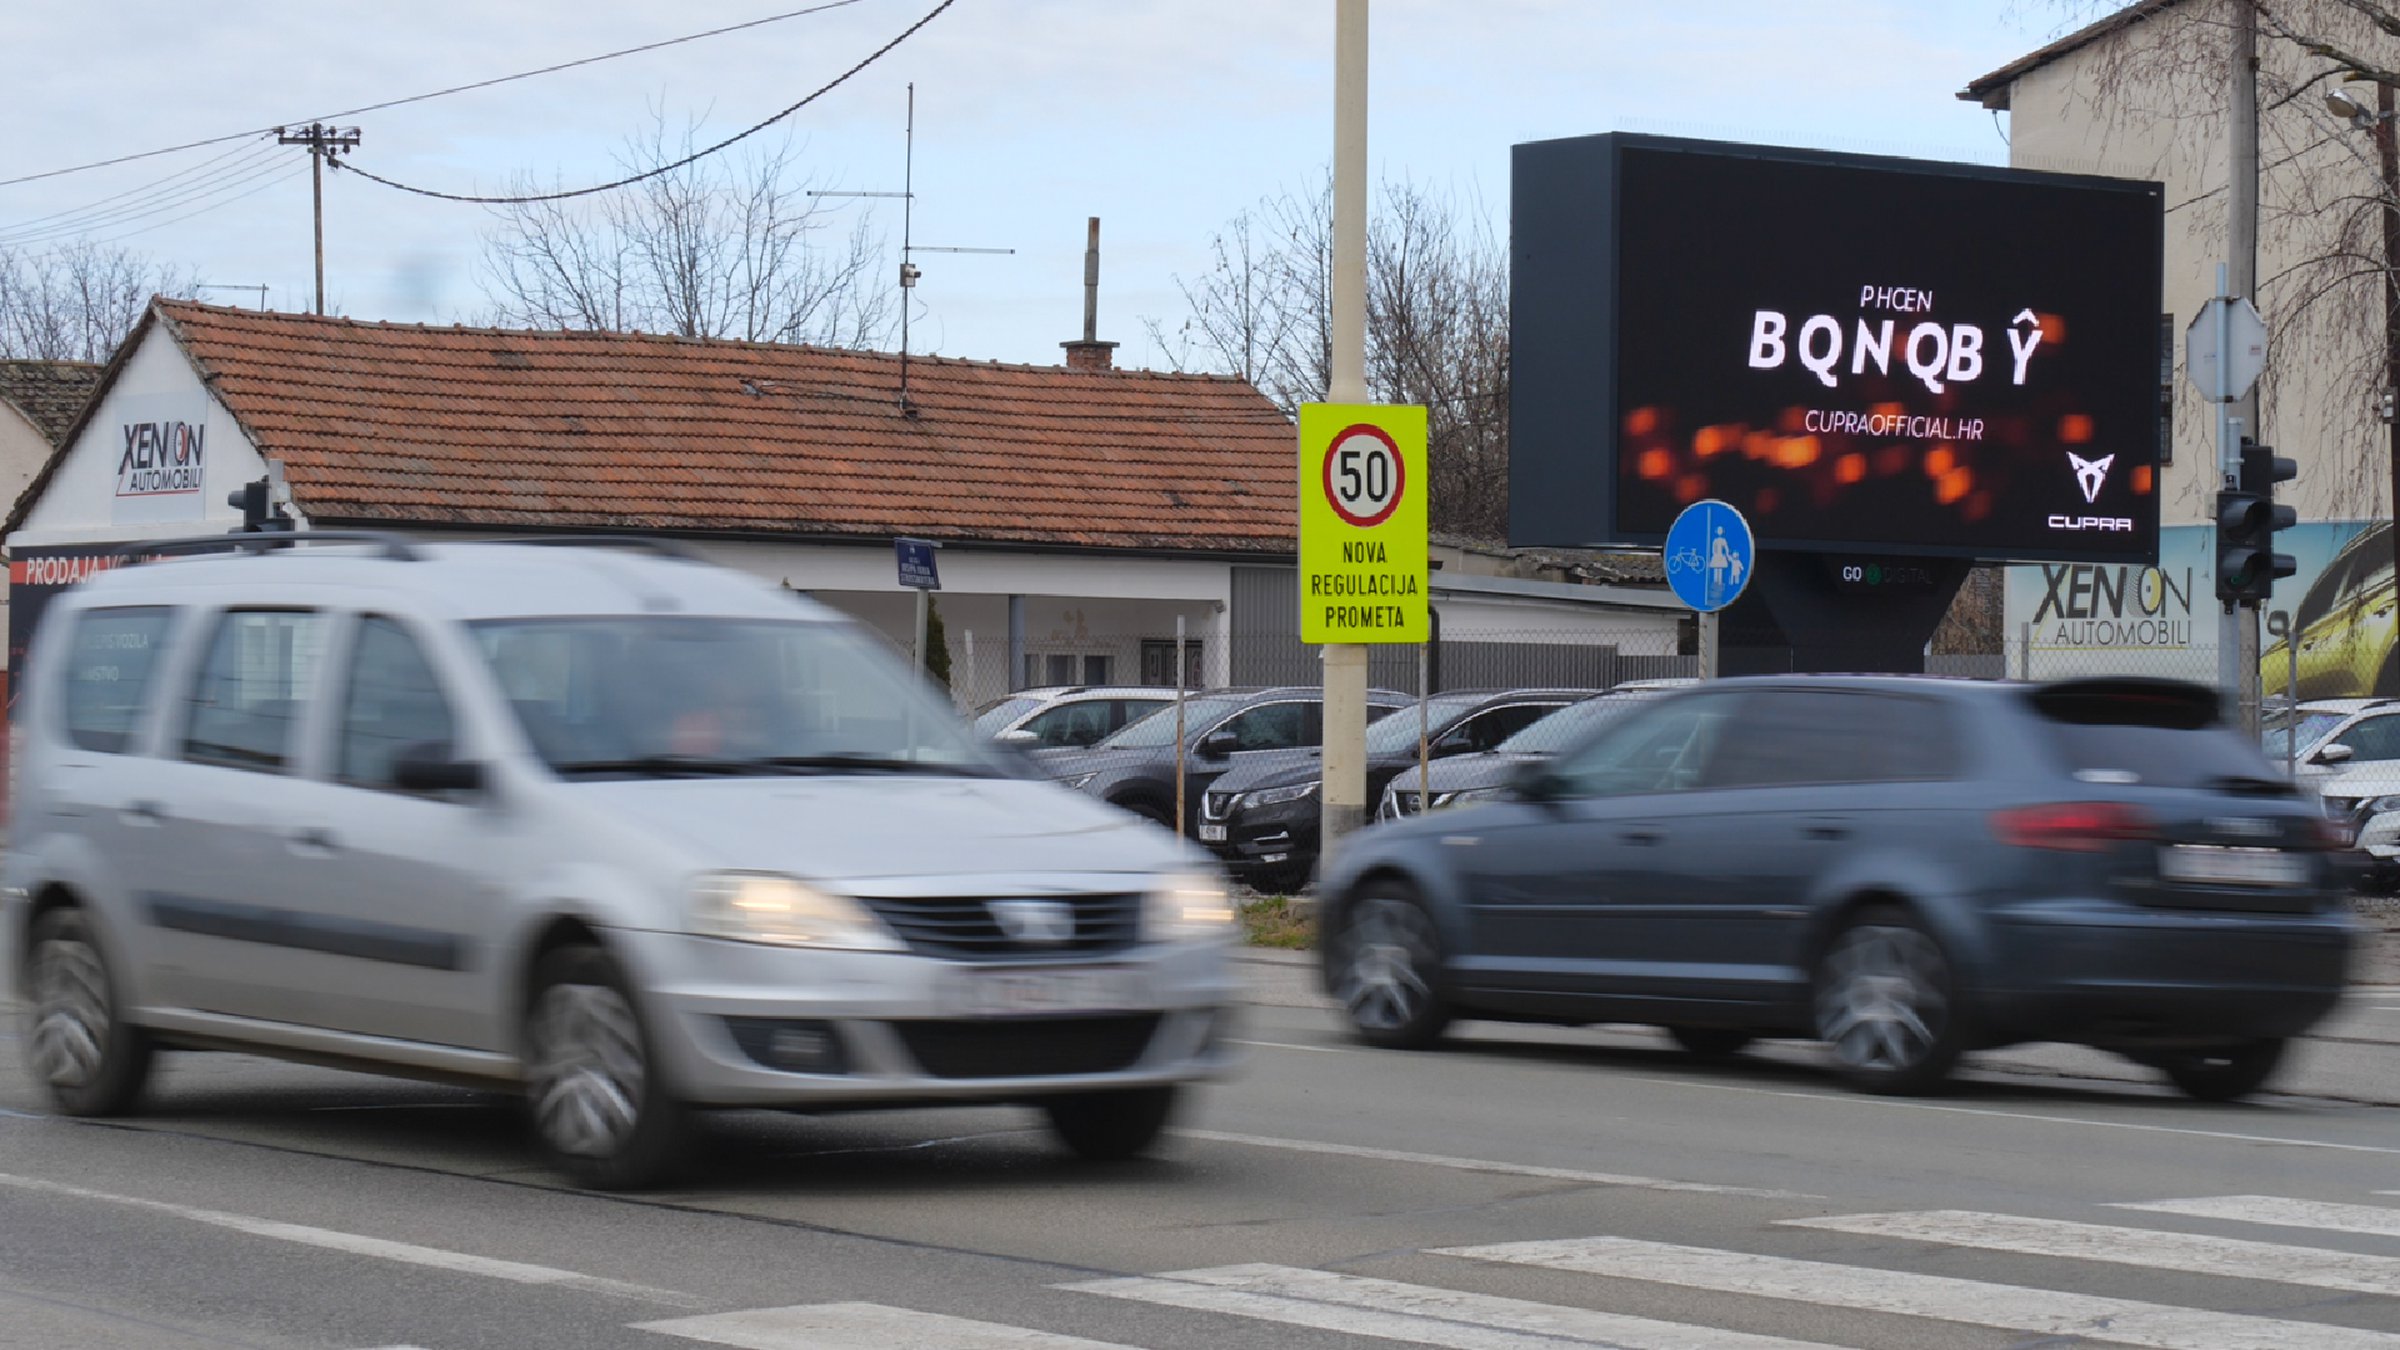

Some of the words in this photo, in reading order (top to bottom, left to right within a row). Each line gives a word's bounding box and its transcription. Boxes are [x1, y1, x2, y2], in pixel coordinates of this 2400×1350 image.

[1804, 409, 1985, 441] CUPRAOFFICIAL.HR
[118, 421, 205, 476] XENON
[130, 468, 204, 491] AUTOMOBILI
[1340, 450, 1389, 503] 50
[2047, 514, 2133, 532] CUPRA
[1343, 541, 1387, 563] NOVA
[26, 555, 100, 585] PRODAJA
[1842, 565, 1863, 582] GO
[1312, 574, 1418, 596] REGULACIJA
[2034, 563, 2193, 624] XENON
[1325, 605, 1405, 628] PROMETA
[2054, 619, 2192, 645] AUTOMOBILI
